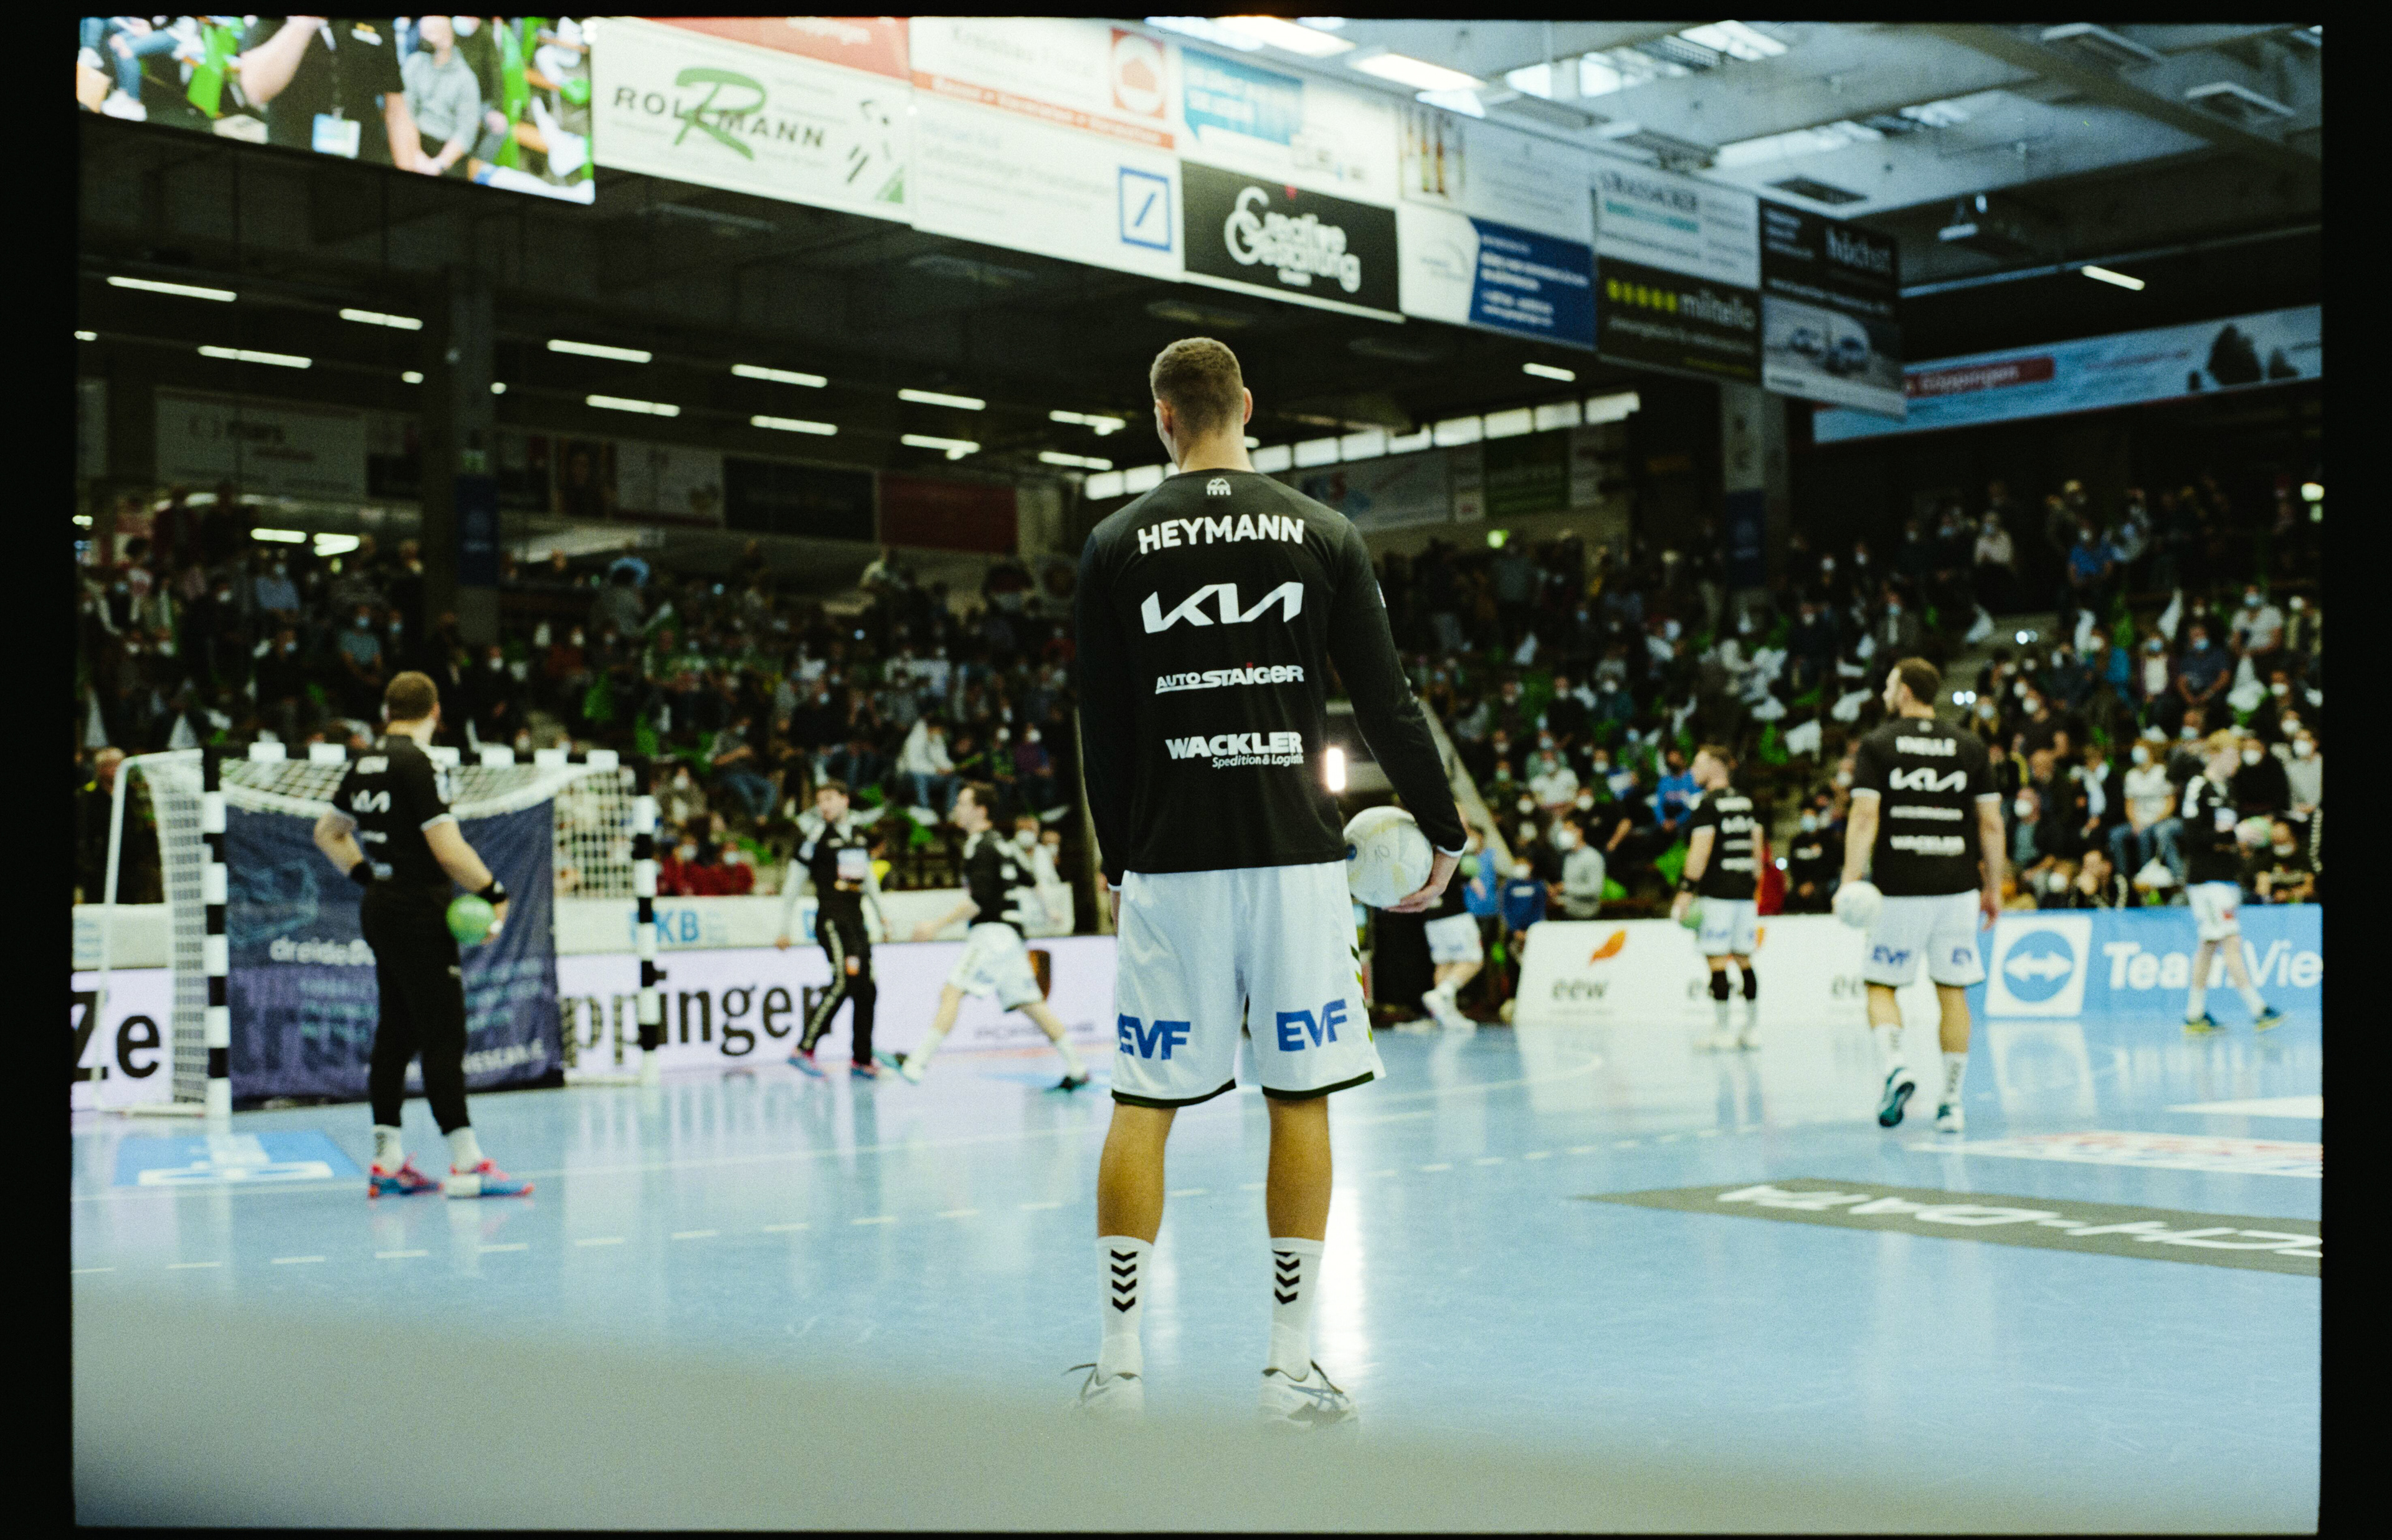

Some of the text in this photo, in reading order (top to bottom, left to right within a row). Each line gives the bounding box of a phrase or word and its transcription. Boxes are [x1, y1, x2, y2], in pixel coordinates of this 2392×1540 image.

[1137, 513, 1304, 554] HEYMANN
[1141, 581, 1304, 634] KIA
[1156, 672, 1200, 687] AUTO
[1165, 732, 1304, 760] WACKLER
[1212, 753, 1304, 770] Spedition & Logistik
[1553, 978, 1610, 999] eew
[1118, 1013, 1191, 1060] EVF
[1276, 998, 1348, 1052] EVF
[1717, 1184, 2323, 1257] CH-DATA
